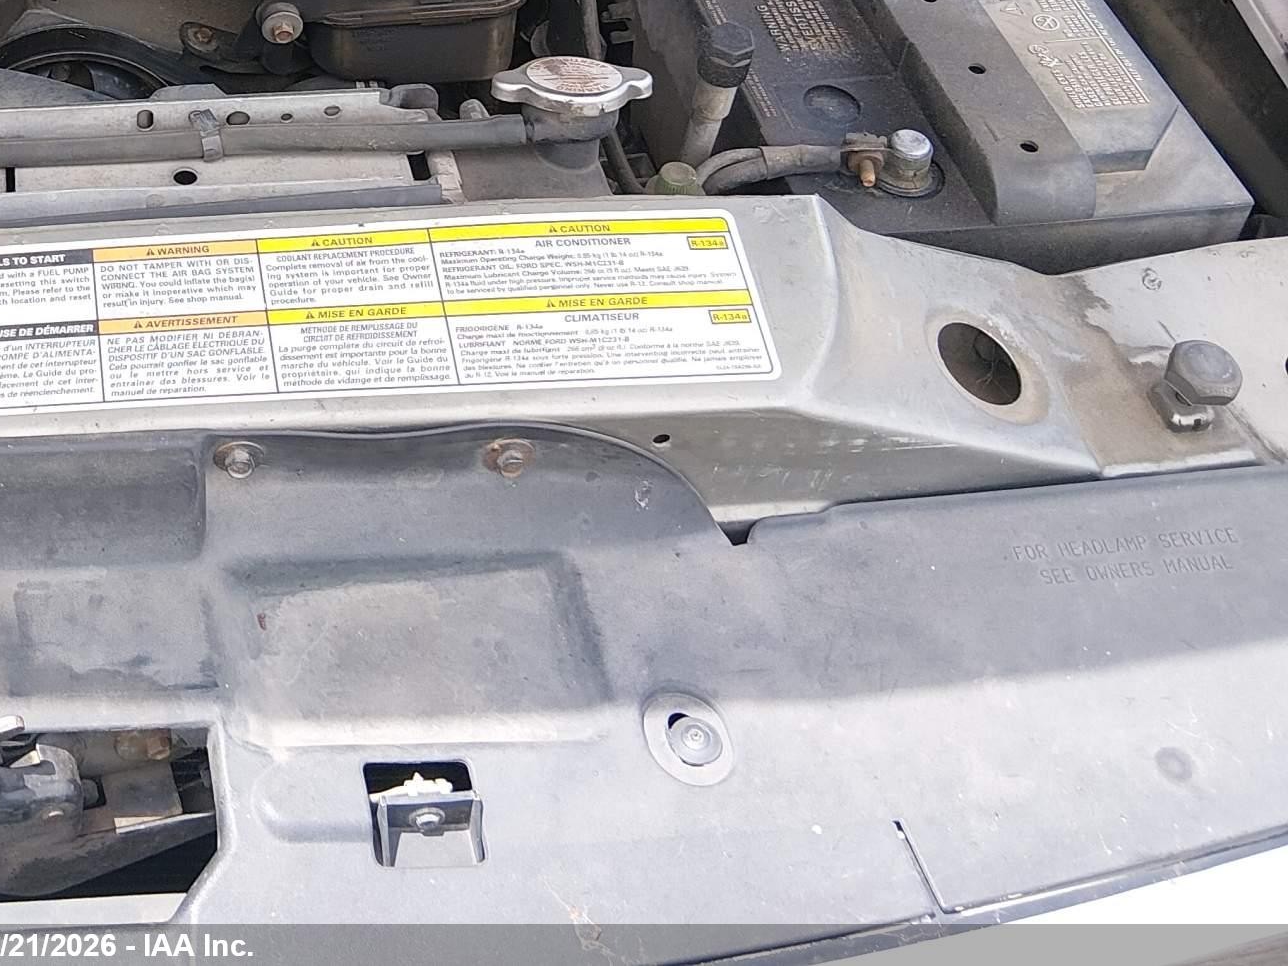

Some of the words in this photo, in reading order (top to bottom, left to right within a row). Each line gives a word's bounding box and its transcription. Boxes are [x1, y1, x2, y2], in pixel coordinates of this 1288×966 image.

[756, 5, 790, 52] WARNING
[559, 224, 610, 233] CAUTION
[321, 236, 372, 246] CAUTION
[535, 239, 553, 247] AIR
[555, 237, 630, 246] CONDITIONER
[156, 245, 209, 255] WARNING
[369, 247, 414, 257] PROCEDURE
[11, 256, 27, 265] TO
[29, 253, 65, 264] START
[99, 264, 114, 272] DO
[118, 263, 138, 271] NOT
[143, 260, 182, 270] TAMPER
[186, 258, 211, 267] WITH
[215, 257, 229, 266] OR
[37, 268, 60, 277] FUEL
[62, 266, 89, 275] PUMP
[100, 271, 145, 281] CONNECT
[150, 270, 167, 278] THE
[171, 269, 187, 277] AIR
[191, 267, 211, 276] BAG
[215, 265, 254, 274] SYSTEM
[39, 277, 56, 285] this
[60, 276, 89, 284] switch
[139, 280, 156, 288] You
[158, 278, 182, 287] could
[183, 277, 210, 285] inflate
[212, 276, 226, 284] the
[114, 291, 139, 300] make
[152, 287, 203, 296] inoperative
[206, 284, 233, 292] which
[102, 299, 128, 308] result
[127, 298, 137, 306] in
[167, 295, 184, 304] See
[186, 295, 207, 303] shop
[558, 298, 586, 307] MISE
[589, 297, 604, 306] EN
[608, 296, 647, 305] GARDE
[317, 309, 345, 318] MISE
[348, 308, 363, 317] EN
[367, 306, 406, 316] GARDE
[564, 312, 639, 322] CLIMATISEUR
[145, 315, 237, 328] AVERTISSEMENT
[18, 327, 33, 336] DE
[34, 323, 93, 336] DÉMARRER
[1012, 544, 1048, 562] FOR
[1057, 535, 1147, 558] HEADLAMP
[1158, 527, 1239, 549] SERVICE
[1040, 568, 1076, 585] SEE
[1086, 562, 1155, 581] OWNERS
[1163, 554, 1233, 575] MANUAL
